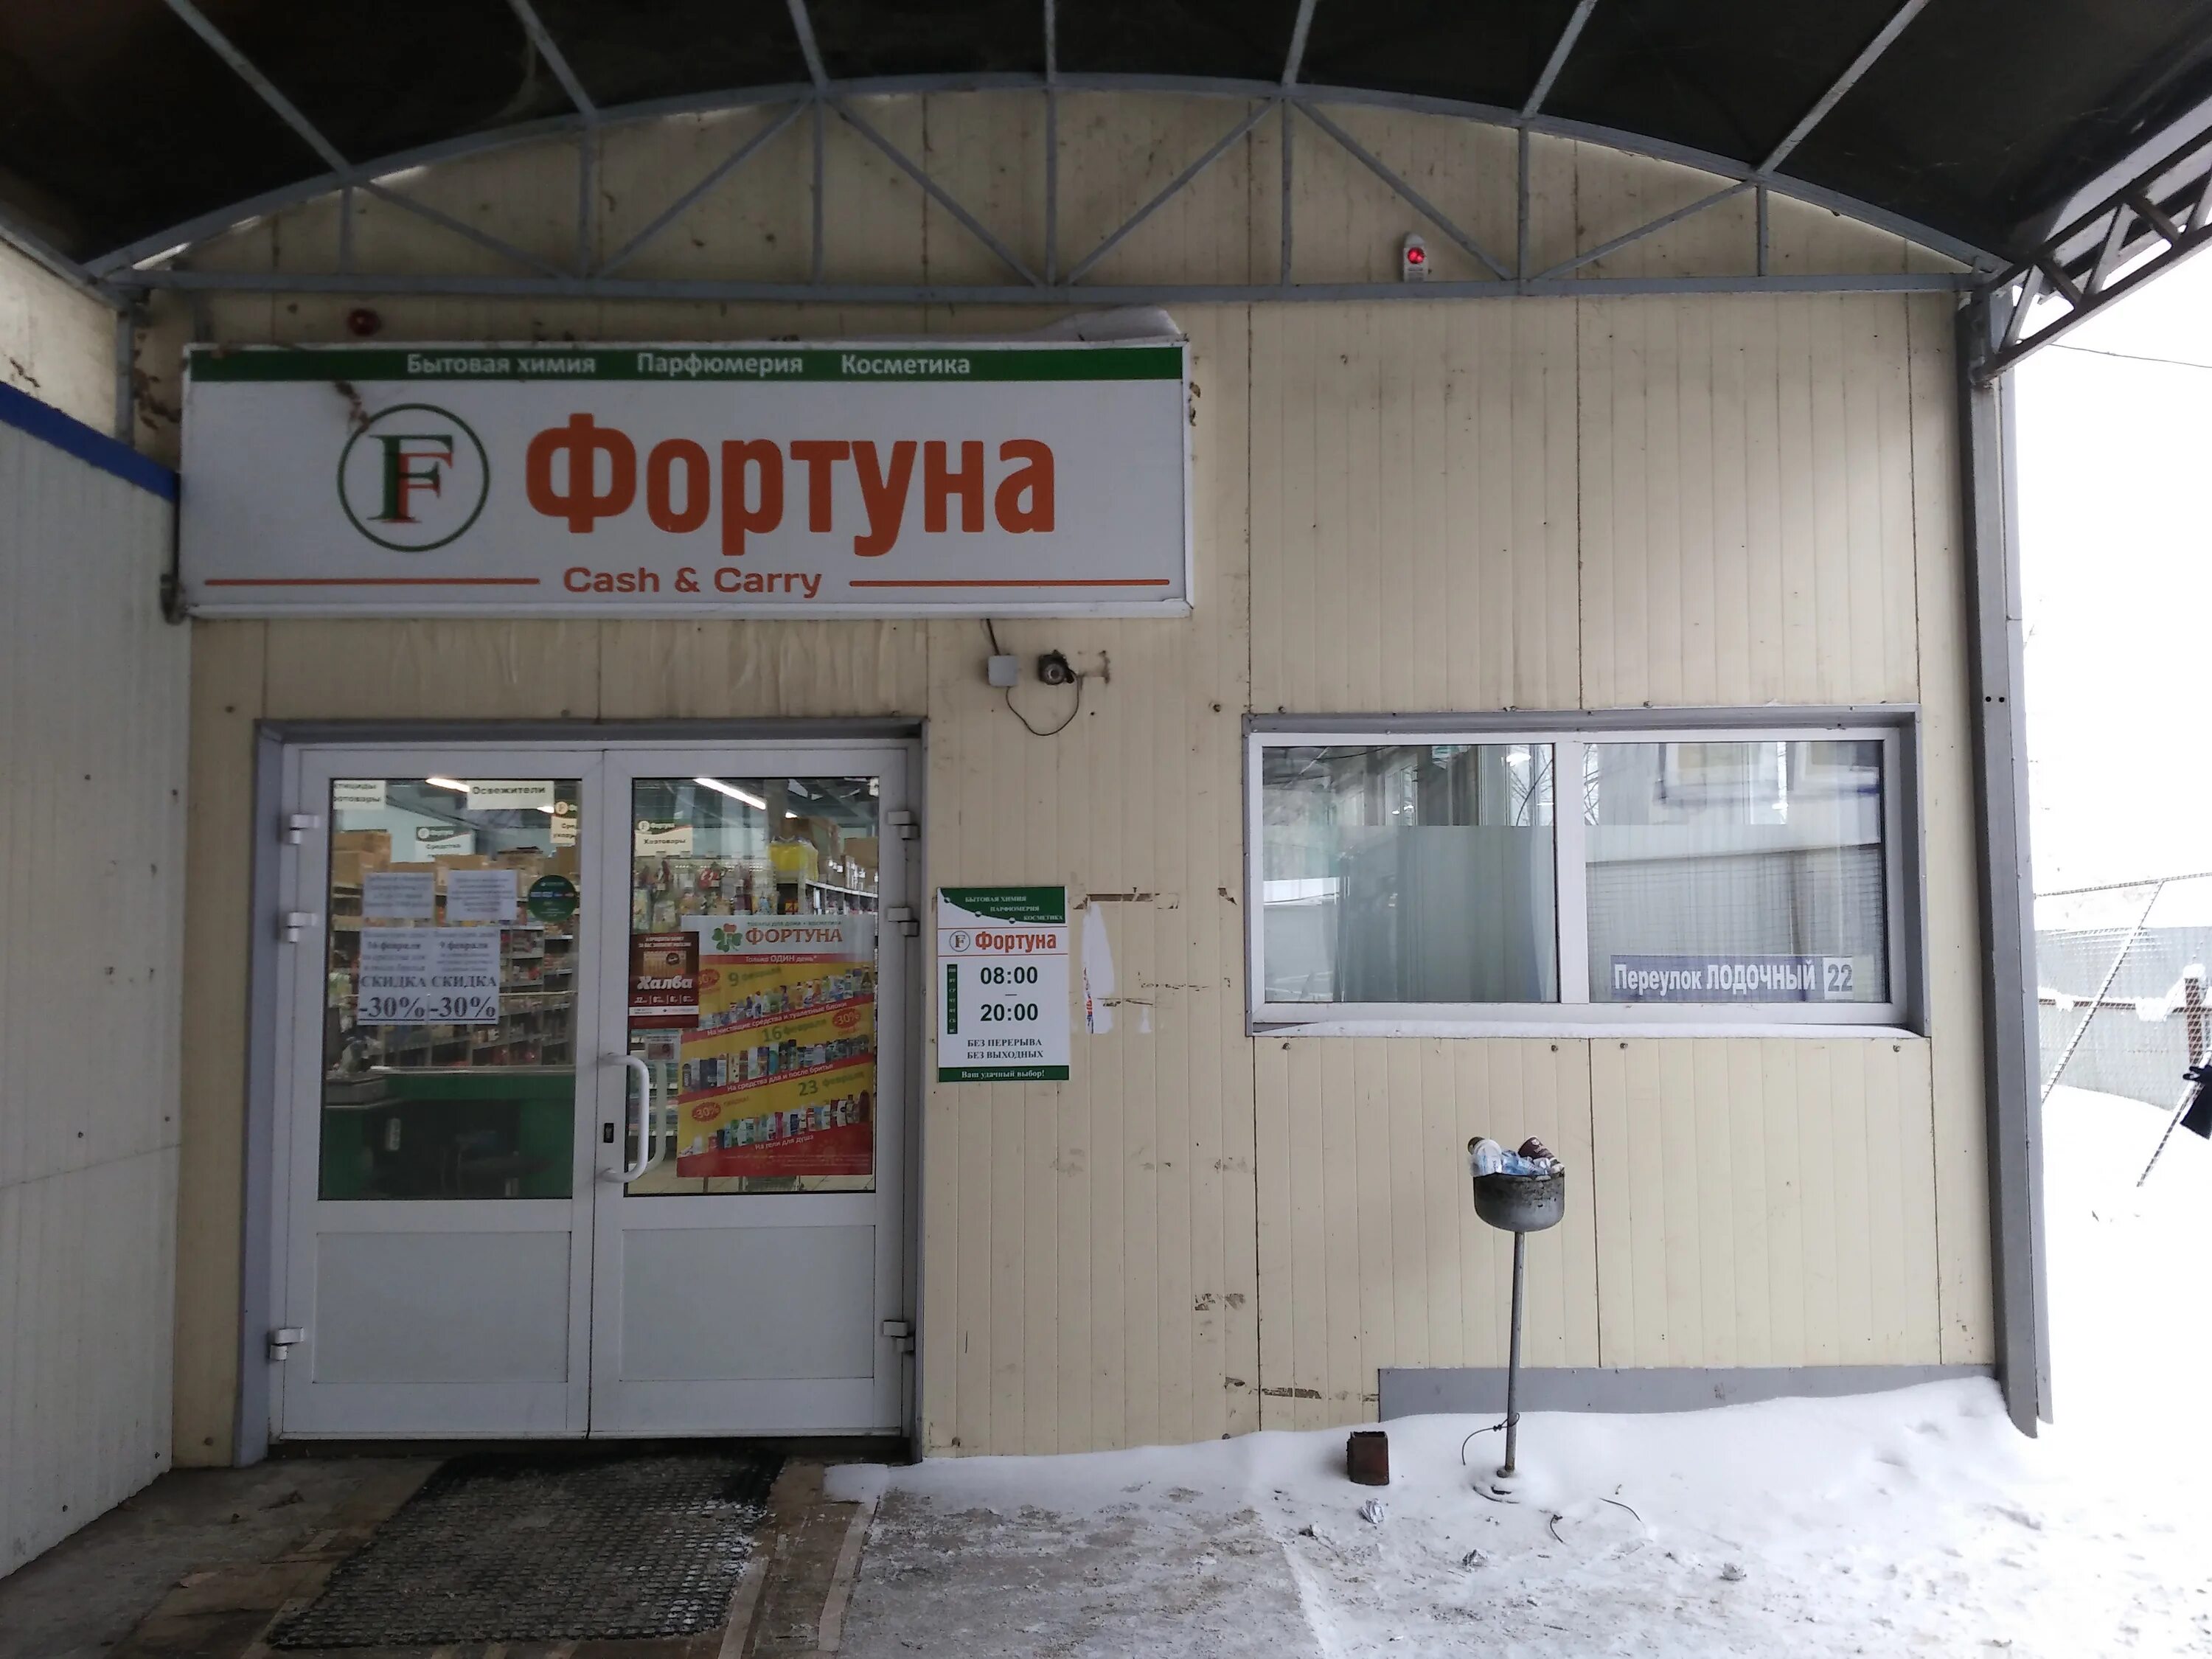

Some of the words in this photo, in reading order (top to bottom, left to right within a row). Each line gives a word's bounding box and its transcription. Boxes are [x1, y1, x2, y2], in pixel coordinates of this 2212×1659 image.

[407, 354, 511, 374] Бытовая
[516, 358, 597, 374] химия
[636, 352, 804, 378] Парфюмерия
[841, 354, 971, 375] Косметика
[525, 412, 1055, 557] Фортуна
[563, 566, 661, 593] Cash
[674, 567, 700, 593] &
[713, 566, 823, 599] Carry
[473, 786, 546, 795] Освежители
[745, 928, 843, 945] ФОРТУНА
[975, 931, 1057, 953] Фортуна
[770, 955, 796, 963] ОДИН
[361, 975, 427, 988] СКИДКА
[431, 975, 497, 988] СКИДКА
[637, 975, 693, 990] Халва
[728, 971, 739, 987] 9
[980, 966, 1038, 984] 08:00
[1614, 964, 1703, 995] Переулок
[1707, 959, 1816, 995] ЛОДОЧНЫЙ
[1826, 964, 1853, 992] 22
[359, 996, 425, 1018] -30%
[430, 996, 496, 1018] -30%
[752, 1015, 782, 1029] средства
[789, 1006, 825, 1020] туалетные
[826, 1001, 848, 1011] блоки
[980, 1003, 1039, 1021] 20:00
[834, 1010, 861, 1026] -30%
[762, 1029, 782, 1042] 16
[967, 1039, 986, 1047] БЕЗ
[988, 1038, 1043, 1047] ПЕРЕРЫВА
[967, 1051, 984, 1060] БЕЗ
[987, 1050, 1043, 1060] ВЫХОДНЫХ
[727, 1083, 737, 1092] На
[738, 1077, 768, 1091] средства
[768, 1074, 782, 1084] для
[789, 1069, 808, 1079] после
[809, 1064, 834, 1075] бритья
[961, 1071, 979, 1079] Ваш
[980, 1070, 1015, 1079] удачный
[1017, 1069, 1045, 1079] выбор!
[798, 1080, 818, 1097] 23
[693, 1102, 722, 1119] -30%
[782, 1138, 795, 1147] для
[796, 1135, 814, 1144] душа
